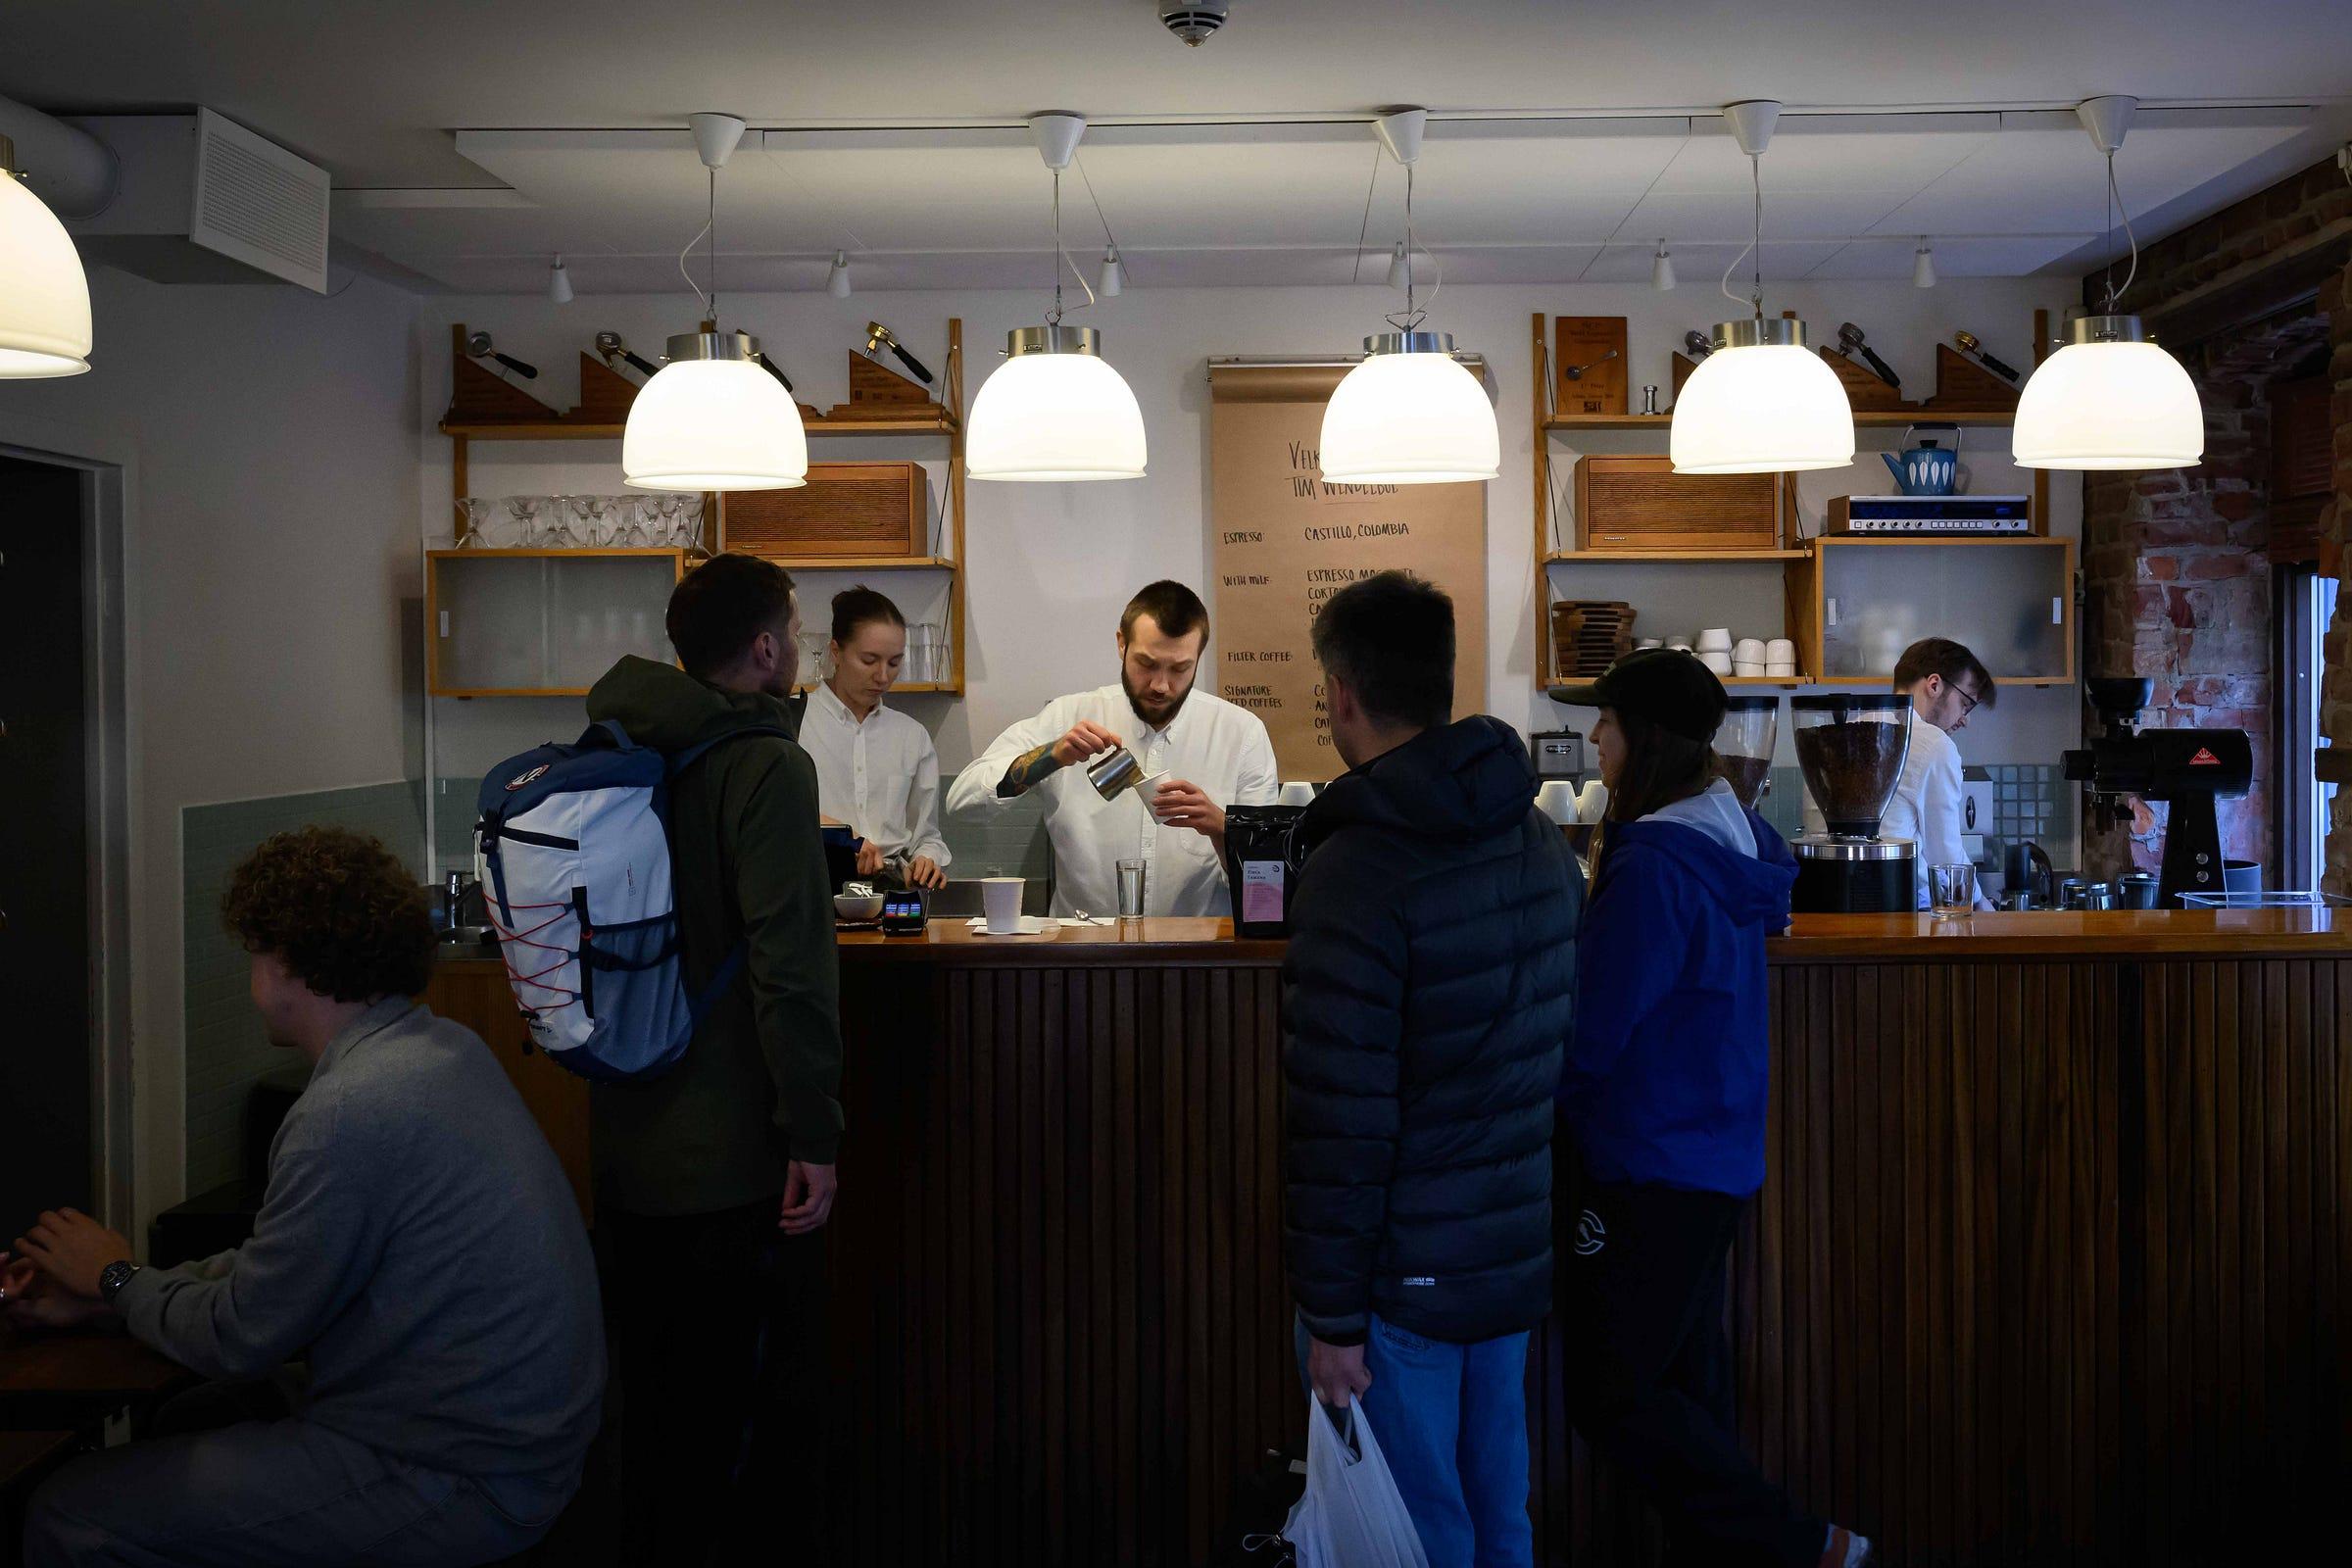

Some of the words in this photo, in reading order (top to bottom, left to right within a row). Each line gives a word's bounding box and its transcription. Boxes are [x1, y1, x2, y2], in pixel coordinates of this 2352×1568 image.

[1284, 475, 1316, 500] TIM
[1357, 523, 1410, 537] COLOMBIA
[1306, 568, 1354, 583] ESPRESSO
[1227, 651, 1256, 662] FILTER
[1224, 685, 1273, 697] SIGNATURE
